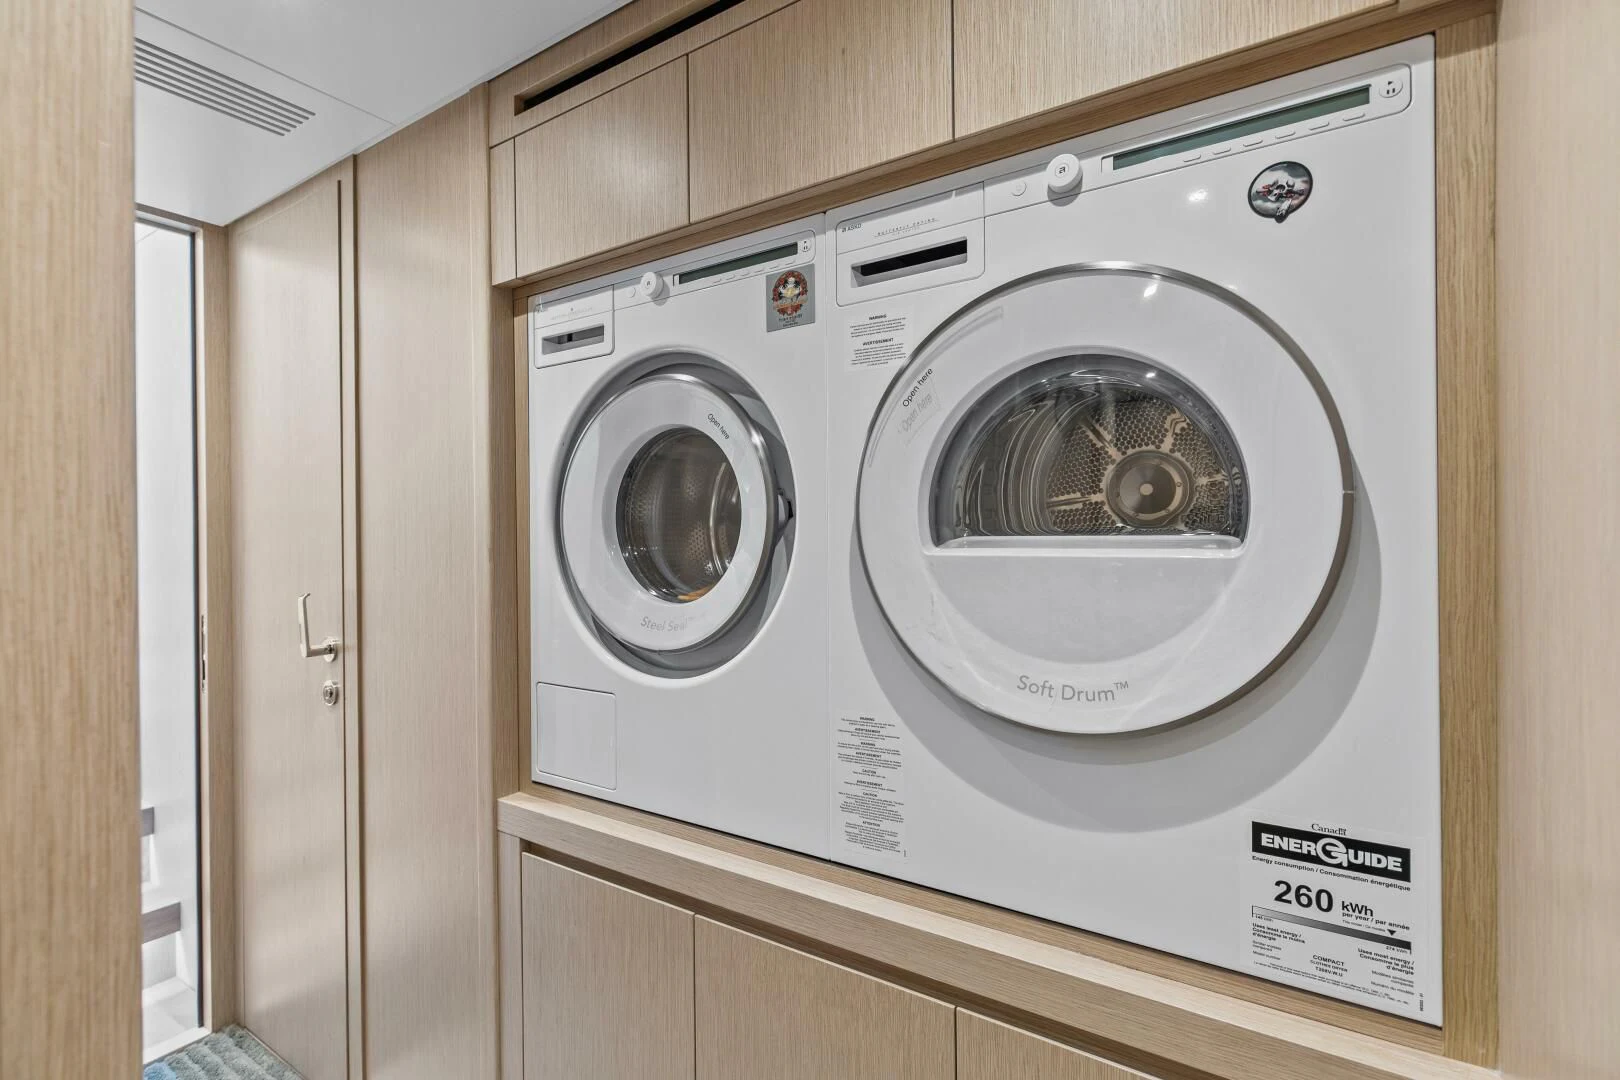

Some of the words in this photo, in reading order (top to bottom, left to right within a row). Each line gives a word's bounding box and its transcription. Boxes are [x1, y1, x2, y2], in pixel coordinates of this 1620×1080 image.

[903, 386, 919, 407] Open
[917, 368, 933, 385] here
[708, 413, 720, 428] Open
[720, 425, 729, 439] here
[640, 616, 665, 631] Steel
[1017, 675, 1054, 698] Soft
[1311, 823, 1347, 836] Canada
[1252, 855, 1273, 864] Energy
[1274, 860, 1314, 873] consumption
[1319, 868, 1369, 883] Consommation
[1370, 877, 1411, 892] énergétique
[1274, 879, 1334, 913] 260
[1341, 900, 1373, 917] kWh
[1280, 929, 1298, 938] energy
[1388, 921, 1410, 931] année
[1312, 954, 1345, 966] COMPACT
[1358, 947, 1373, 955] Uses
[1390, 955, 1410, 965] energy
[1360, 954, 1392, 965] Consomme
